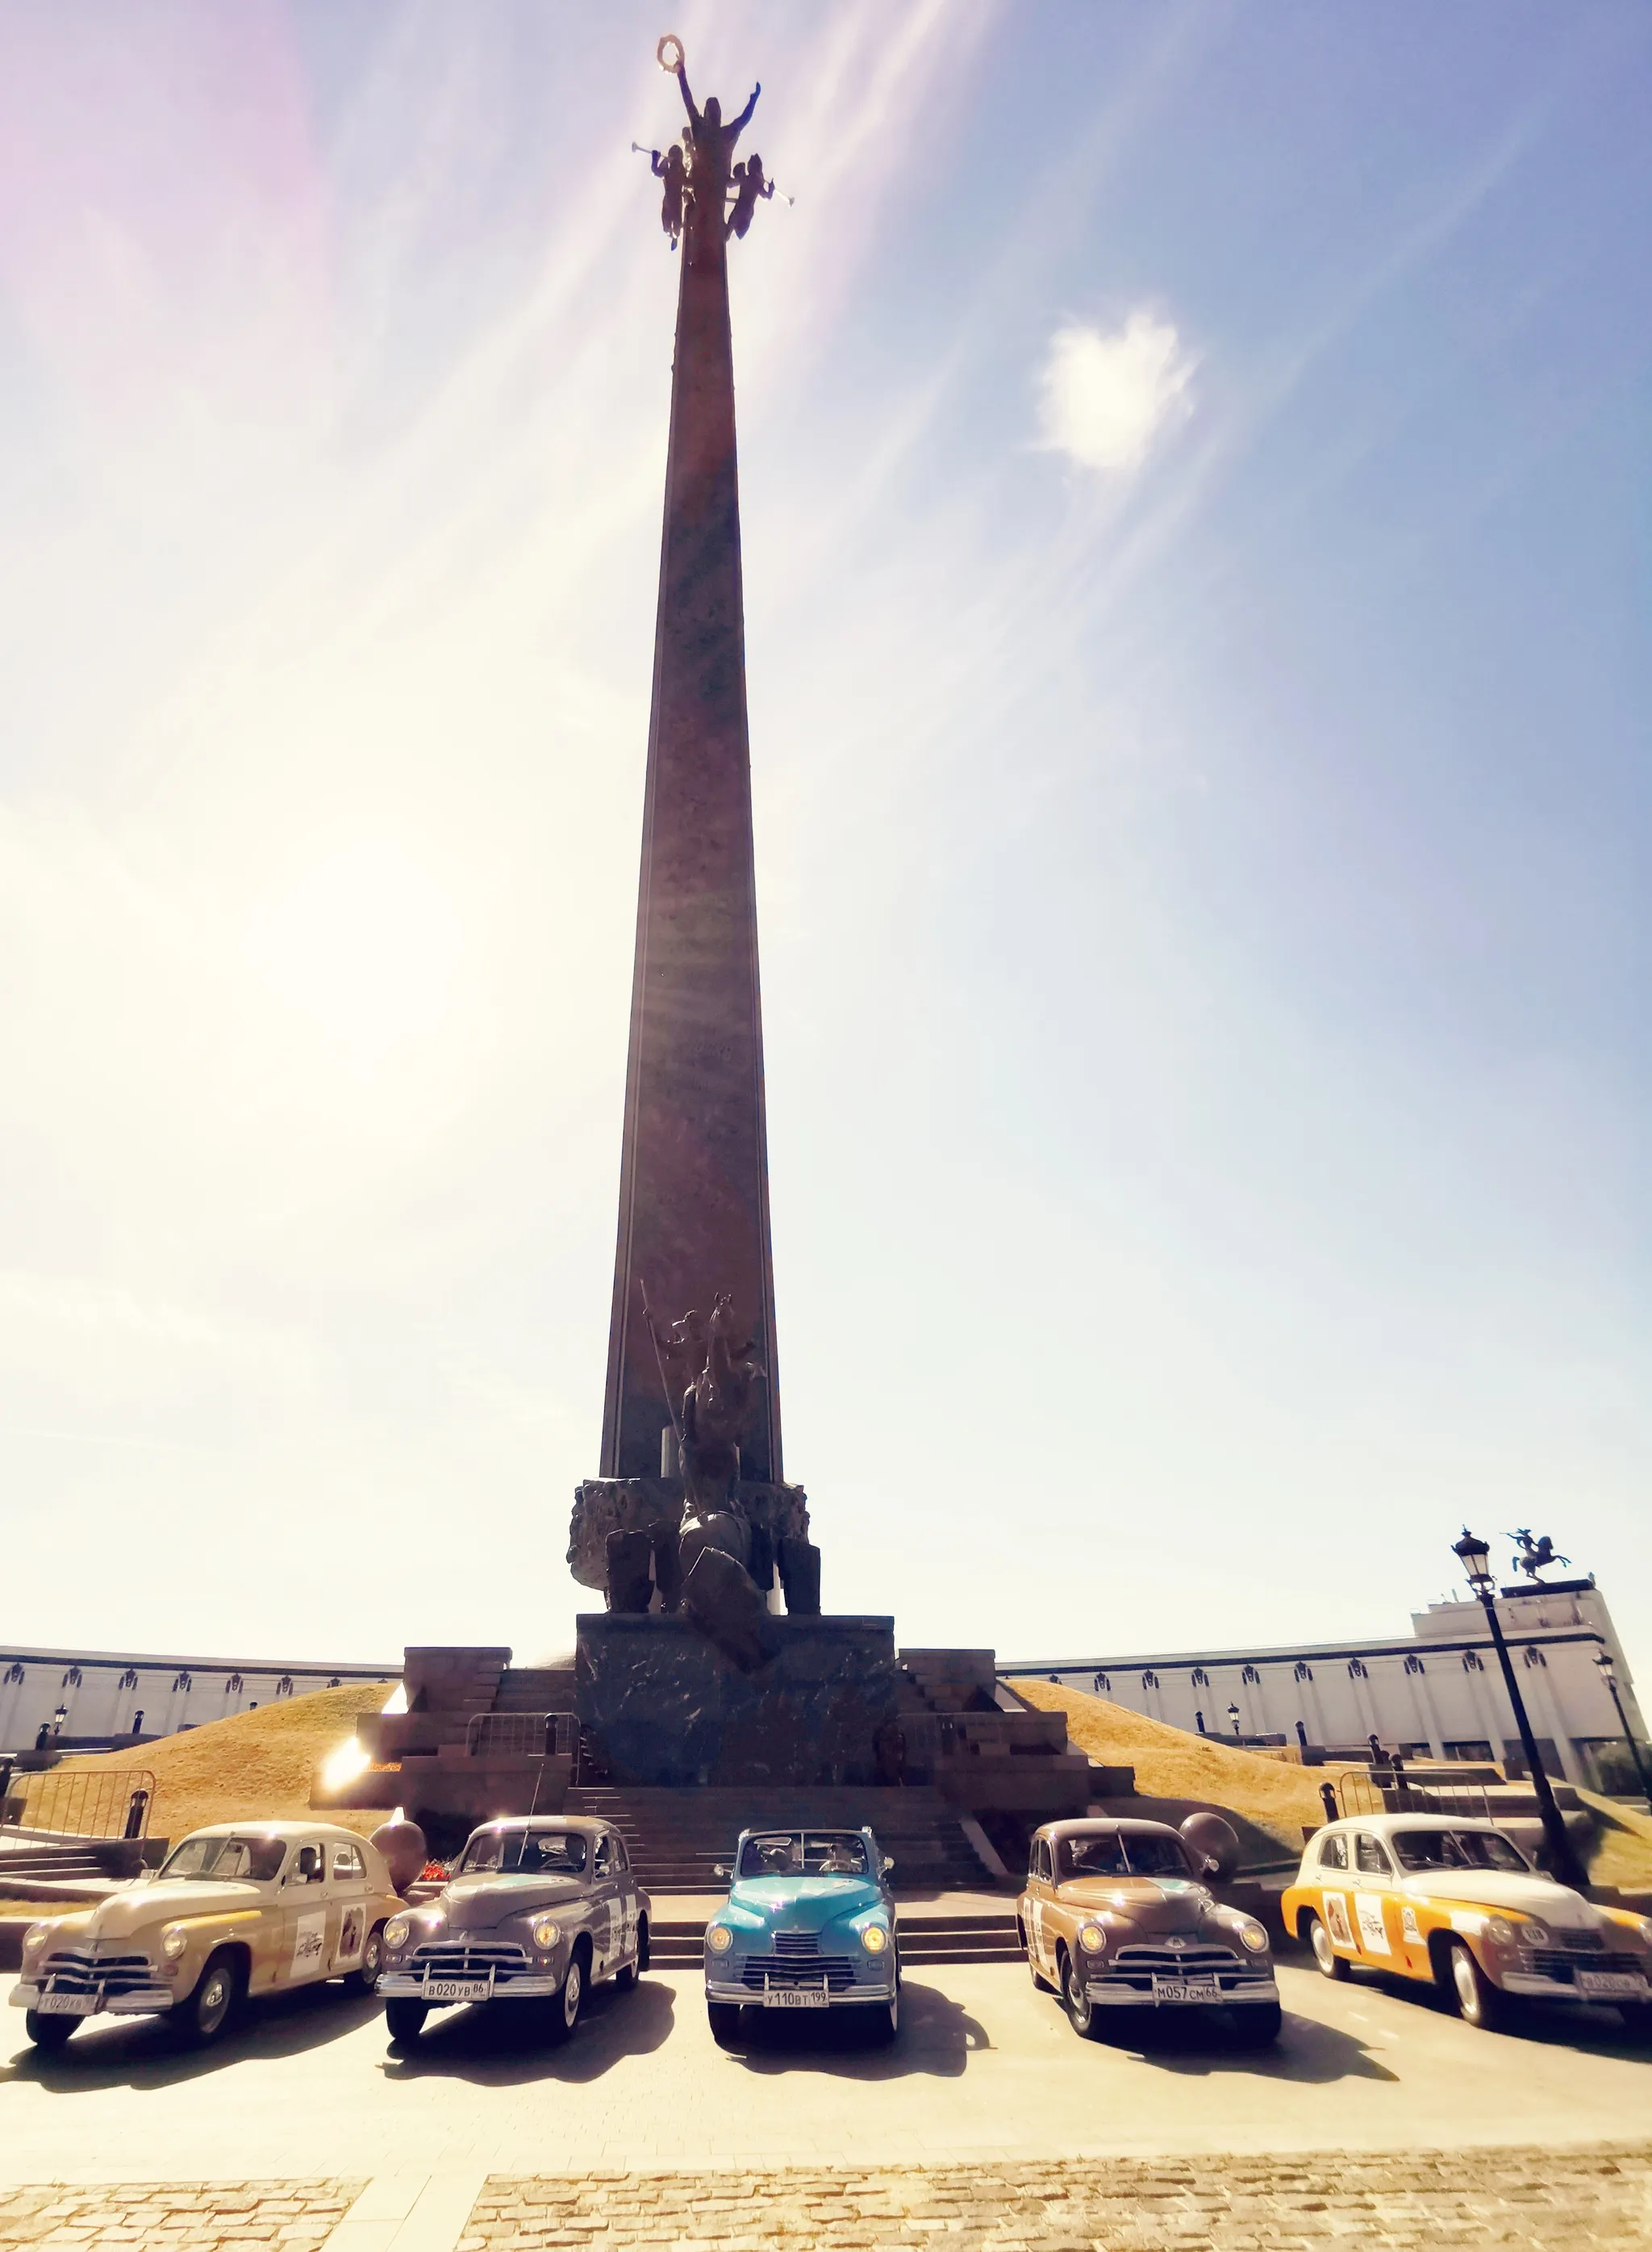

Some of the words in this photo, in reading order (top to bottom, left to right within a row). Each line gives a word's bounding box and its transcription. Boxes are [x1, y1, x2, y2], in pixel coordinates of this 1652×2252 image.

[428, 1983, 471, 1996] В020УВ
[473, 1983, 484, 1993] 86
[1205, 1987, 1217, 1998] 66
[766, 1992, 808, 2005] У110ВТ
[811, 1991, 826, 2002] 199
